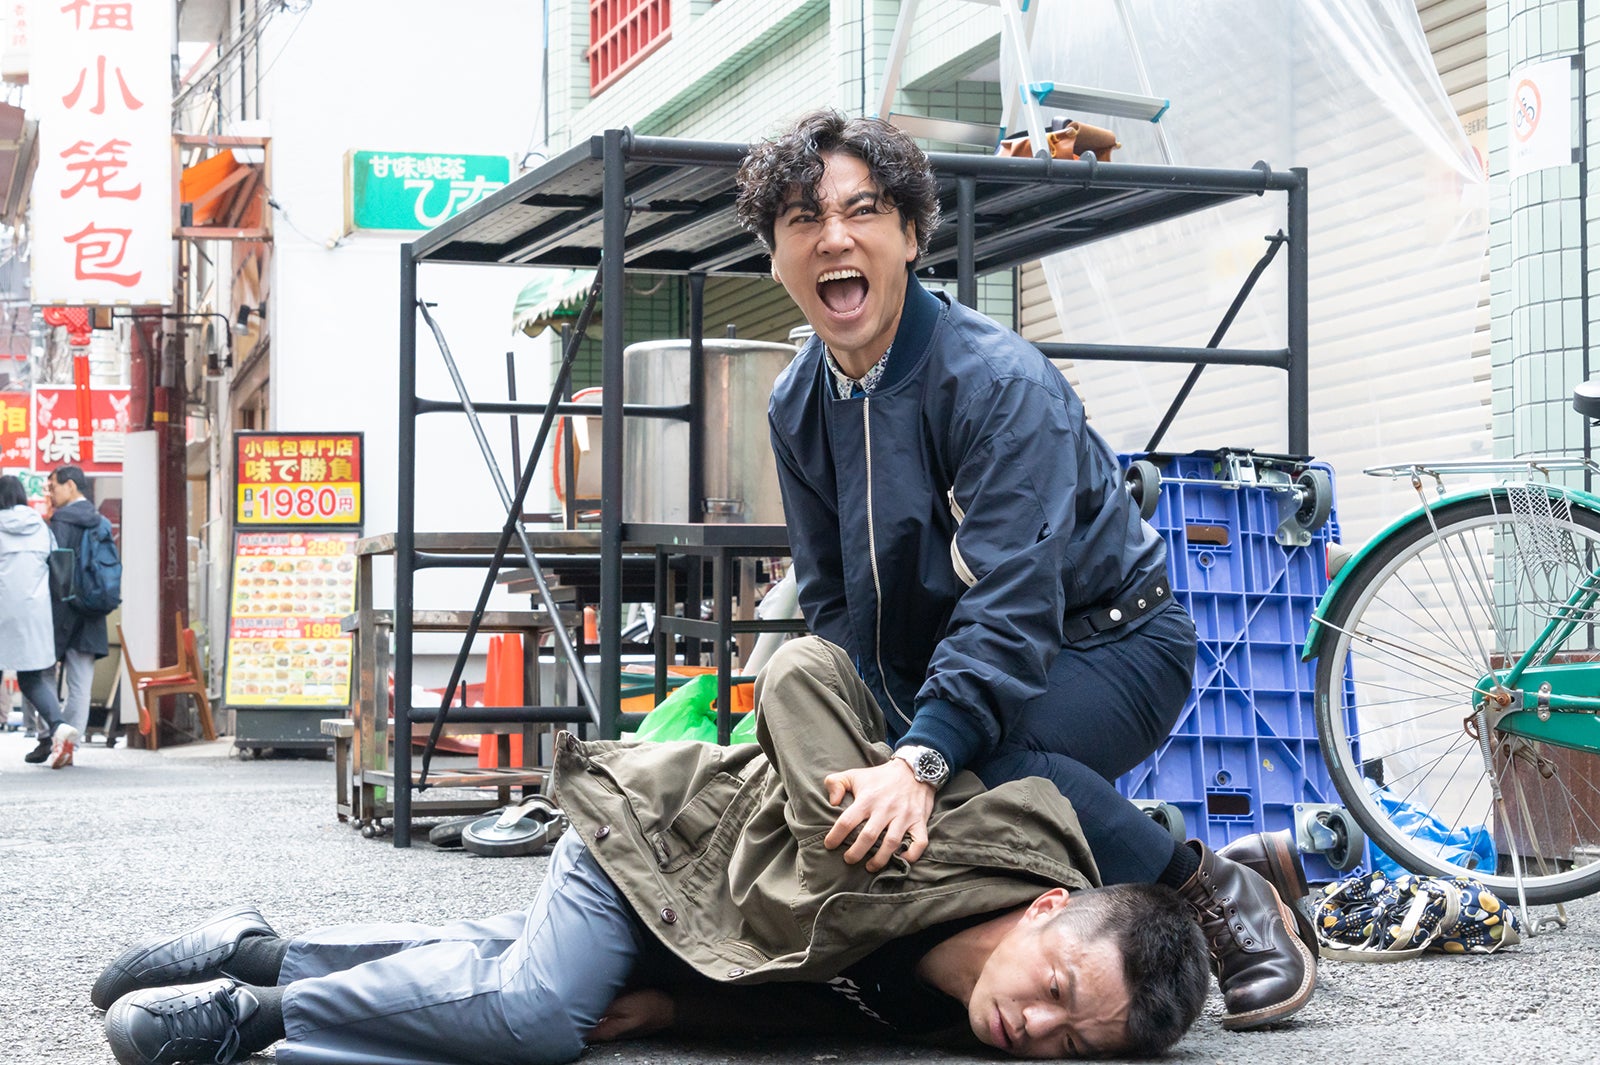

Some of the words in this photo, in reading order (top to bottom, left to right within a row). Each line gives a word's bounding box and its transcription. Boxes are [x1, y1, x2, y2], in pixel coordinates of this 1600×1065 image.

[369, 155, 466, 180] 甘味喫茶
[244, 457, 353, 482] 味で勝負
[306, 540, 347, 556] 2580
